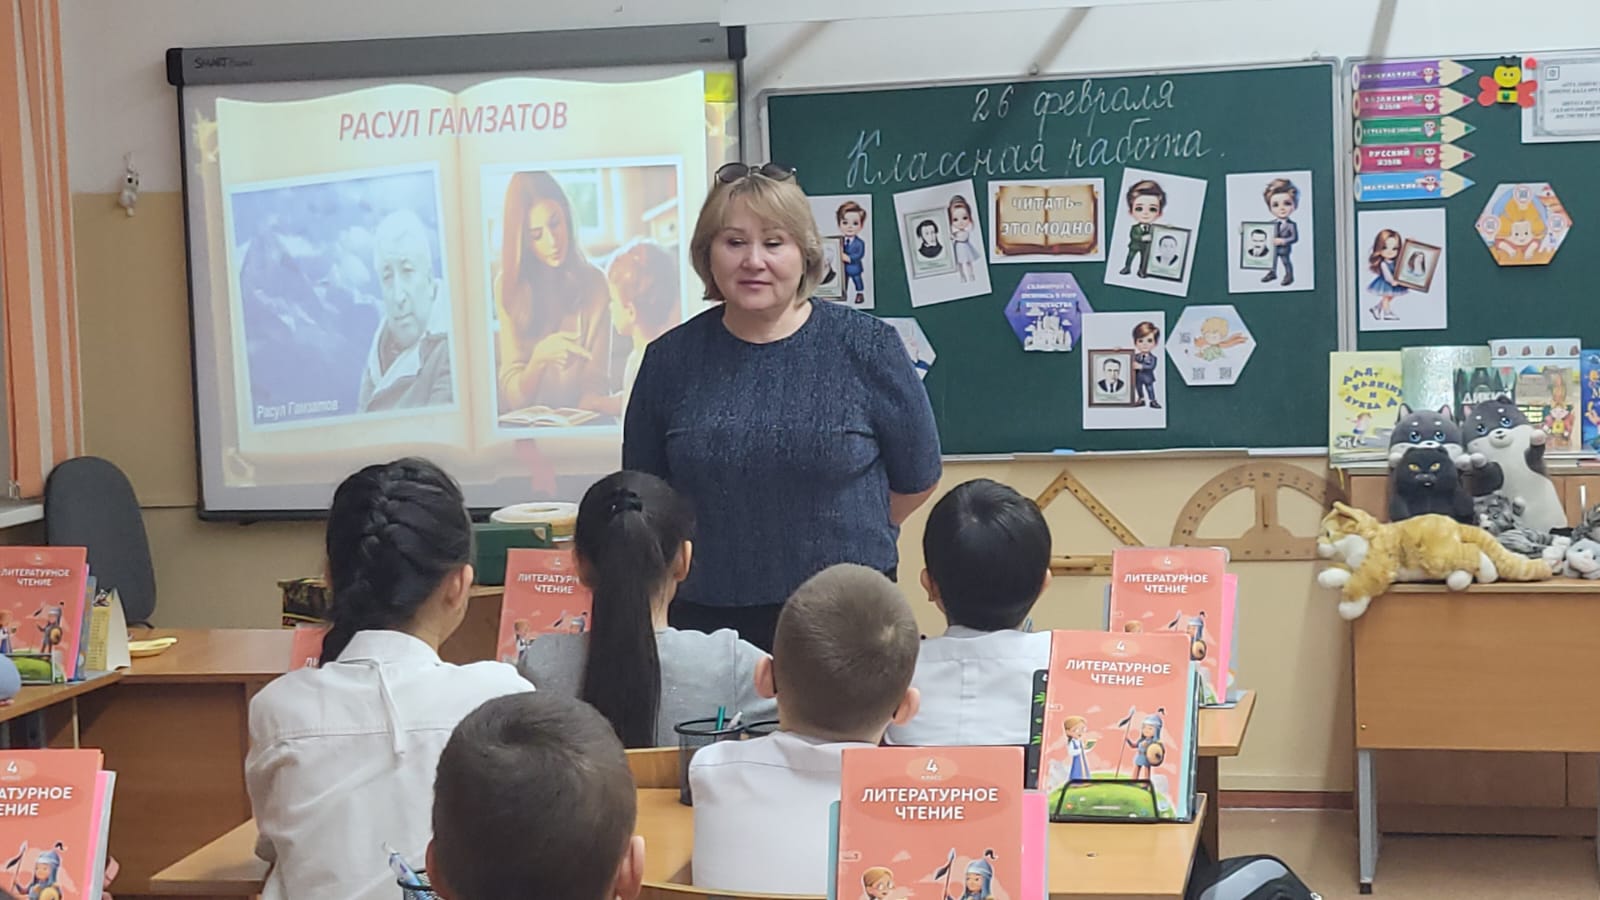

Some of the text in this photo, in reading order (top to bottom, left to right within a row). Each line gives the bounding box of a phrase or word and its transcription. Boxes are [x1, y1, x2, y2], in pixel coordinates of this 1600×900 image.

[972, 79, 1175, 141] 26 февраля
[339, 101, 568, 140] РАСУЛ ГАМЗАТОВ
[846, 128, 1050, 189] Классная
[1001, 222, 1094, 237] ЭТО МОДНО
[0, 568, 70, 577] ЛИТЕРАТУРНОЕ
[518, 573, 580, 583] ЛИТЕРАТУРН
[1124, 573, 1209, 583] ЛИТЕРАТУРНОЕ
[17, 578, 52, 586] ЧТЕНИЕ
[534, 584, 575, 594] ЧТЕНИЕ
[1144, 584, 1188, 594] ЧТЕНИЕ
[1116, 641, 1125, 651] 4
[1065, 658, 1171, 675] ЛИТЕРАТУРНОЕ
[1091, 673, 1145, 687] ЧТЕНИЕ
[7, 760, 17, 773] 4
[925, 759, 938, 773] 4
[0, 786, 73, 800] АТУРНОЕ
[861, 788, 998, 802] ЛИТЕРАТУРНОЕ
[0, 803, 39, 816] ЕНИЕ
[895, 806, 964, 820] ЧТЕНИЕ
